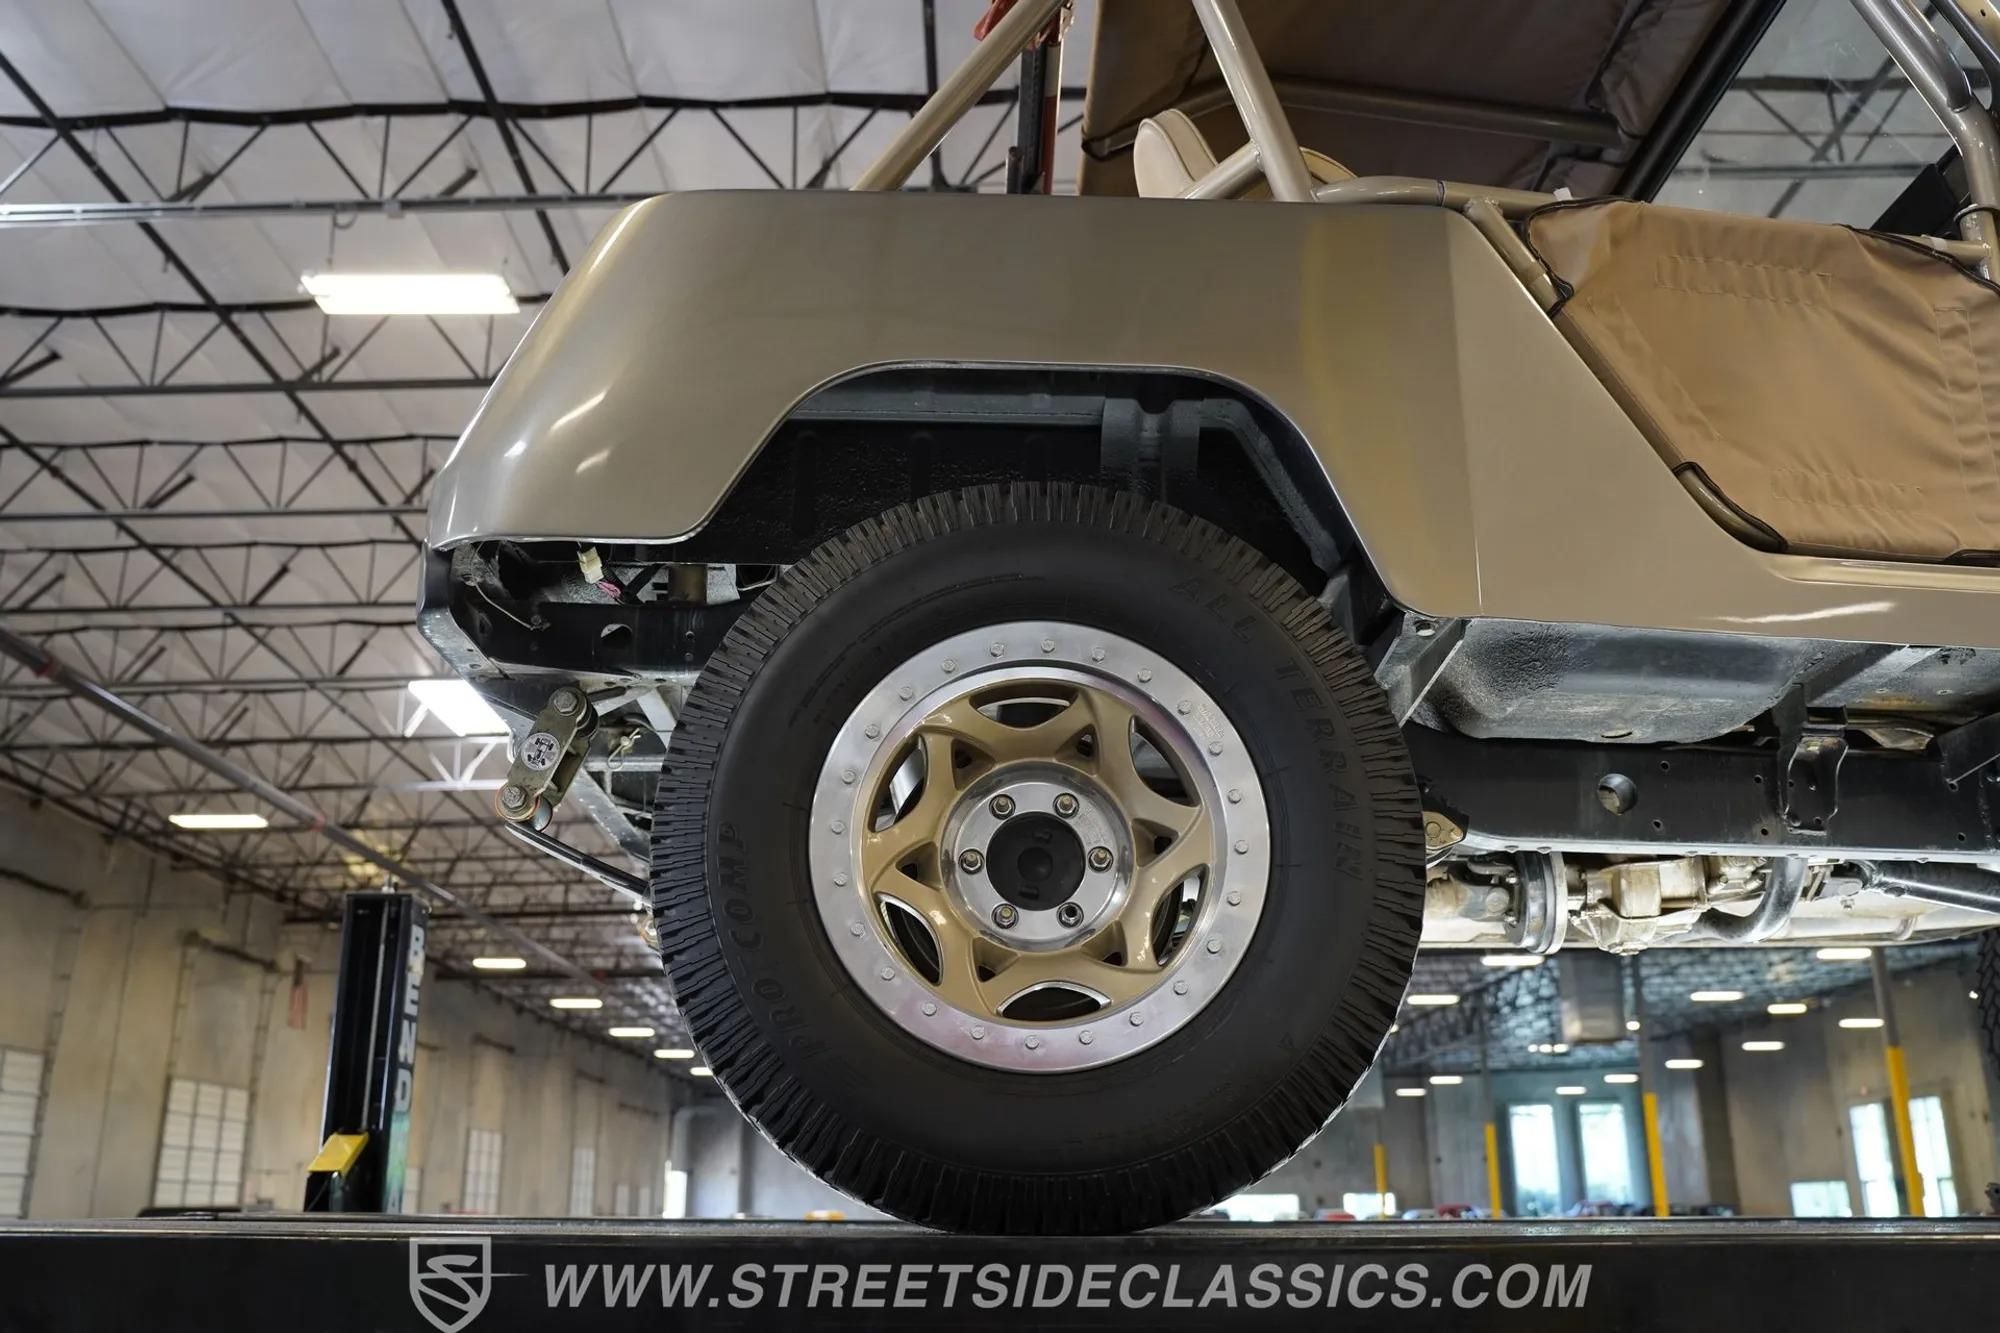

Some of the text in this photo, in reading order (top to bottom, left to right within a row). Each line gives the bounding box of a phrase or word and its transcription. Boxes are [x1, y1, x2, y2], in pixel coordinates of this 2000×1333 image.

[1170, 577, 1364, 880] ALL TERRAIN
[716, 820, 830, 1063] PRO COMP
